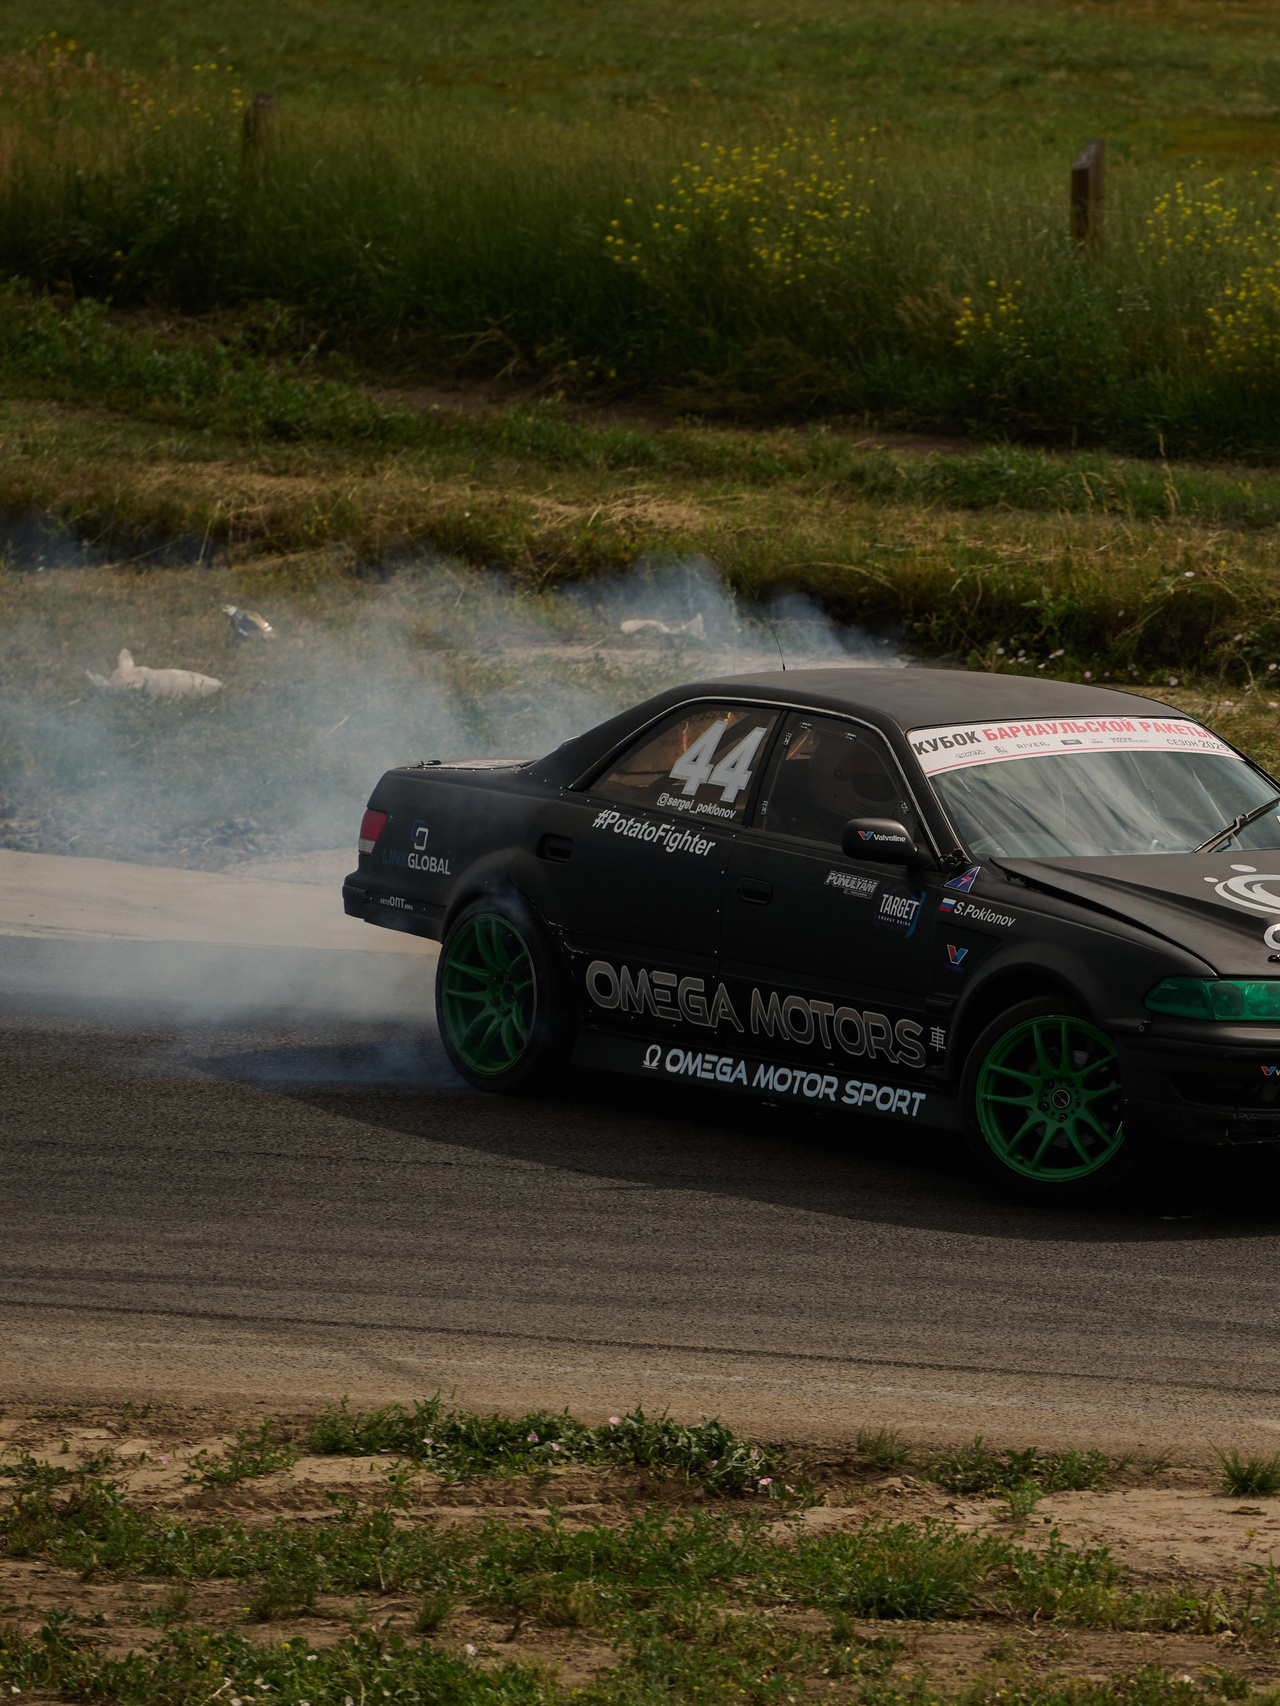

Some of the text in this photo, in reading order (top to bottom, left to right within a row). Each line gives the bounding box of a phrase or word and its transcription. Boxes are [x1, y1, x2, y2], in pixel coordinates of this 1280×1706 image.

[912, 731, 982, 756] КУБОК
[982, 717, 1137, 741] БАРНАУЛЬСКОЙ
[1138, 721, 1214, 740] РАКЕТЫ
[1166, 739, 1230, 752] СЕЗОН 2025
[669, 720, 768, 803] 44
[592, 809, 716, 856] #PotatoFighter
[873, 833, 906, 843] Valvoline
[880, 893, 920, 920] TARGET
[954, 901, 1016, 928] S.Poklonov
[585, 960, 926, 1068] OMEGA MOTORS
[929, 1026, 947, 1052] 車
[665, 1048, 927, 1117] OMEGA MOTOR SPORT
